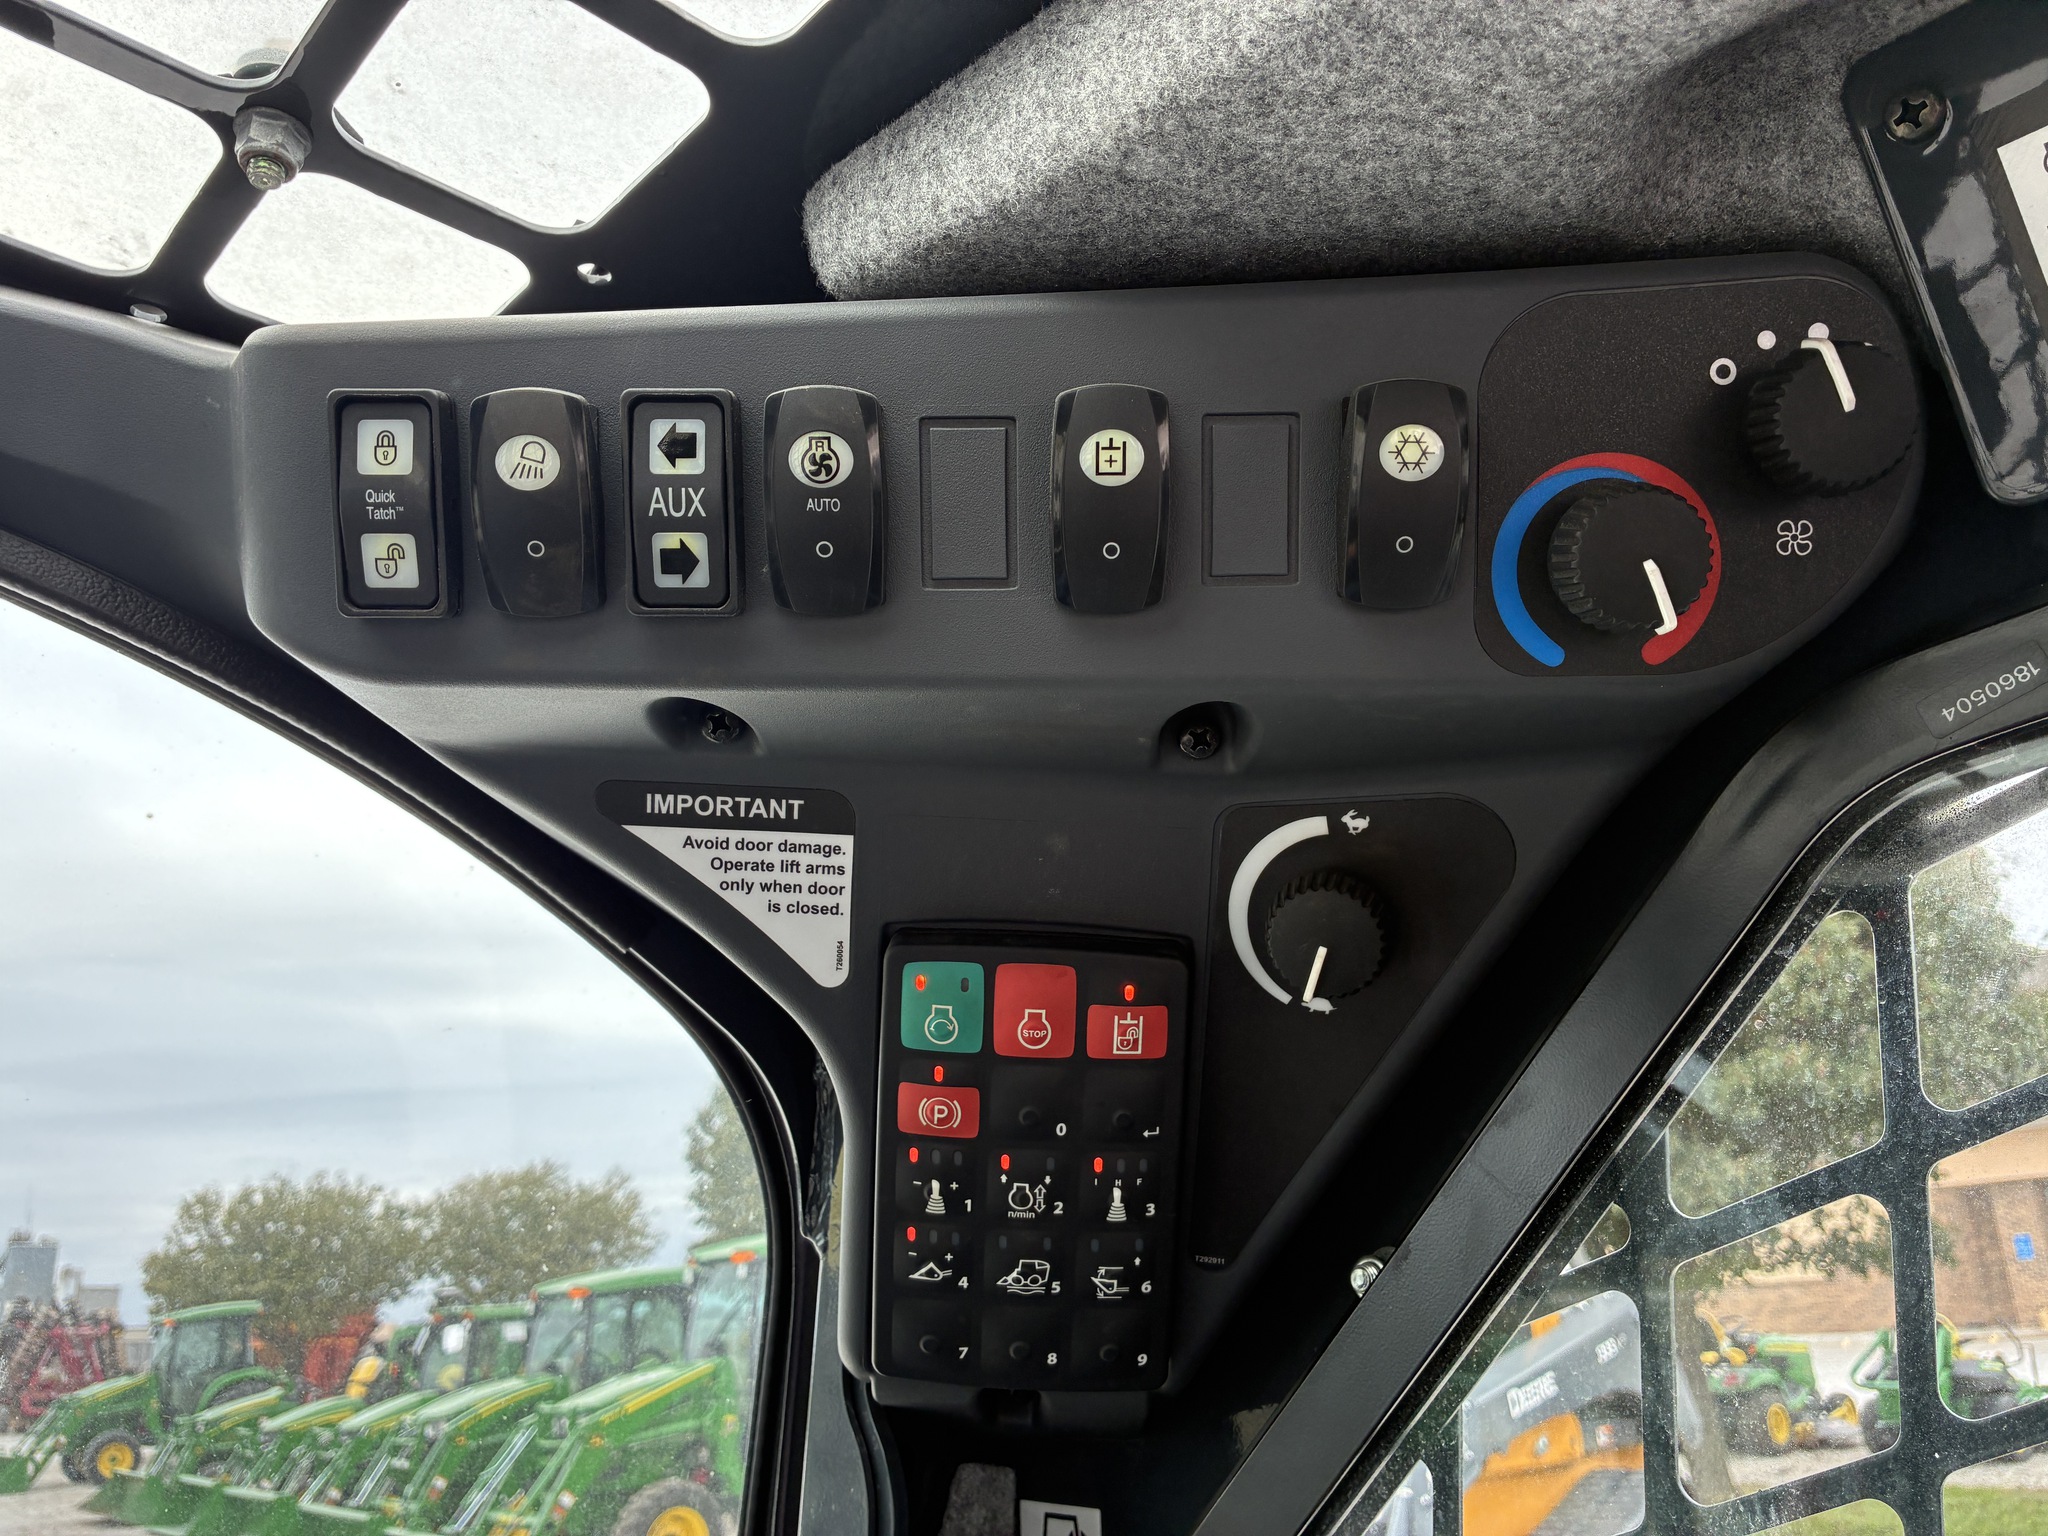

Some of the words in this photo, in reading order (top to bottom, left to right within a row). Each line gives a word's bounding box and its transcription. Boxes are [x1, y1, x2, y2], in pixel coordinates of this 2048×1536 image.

[365, 489, 396, 503] Quick
[648, 486, 707, 518] AUX
[806, 497, 841, 512] AUTO
[1941, 661, 2041, 722] 1860504
[646, 793, 805, 820] IMPORTANT
[682, 835, 730, 851] Avoid
[734, 837, 774, 852] door
[777, 839, 847, 857] damage.
[710, 856, 775, 874] Operate
[780, 859, 802, 874] lift
[805, 862, 846, 876] arms
[718, 878, 755, 895] only
[759, 879, 803, 894] when
[807, 881, 846, 896] door
[767, 899, 782, 913] is
[786, 900, 845, 916] closed.
[835, 940, 844, 972] T260054
[1022, 1029, 1047, 1039] STOP
[934, 1105, 949, 1124] P
[1055, 1122, 1067, 1137] 0
[1114, 1179, 1122, 1187] H
[1136, 1177, 1143, 1186] F
[964, 1198, 973, 1213] 1
[1053, 1201, 1064, 1215] 2
[1145, 1203, 1156, 1217] 3
[1007, 1210, 1036, 1219] n/min
[957, 1276, 970, 1289] 4
[1050, 1281, 1062, 1294] 5
[1140, 1280, 1153, 1294] 6
[958, 1346, 969, 1360] 7
[1046, 1352, 1058, 1366] 8
[1137, 1353, 1148, 1367] 9
